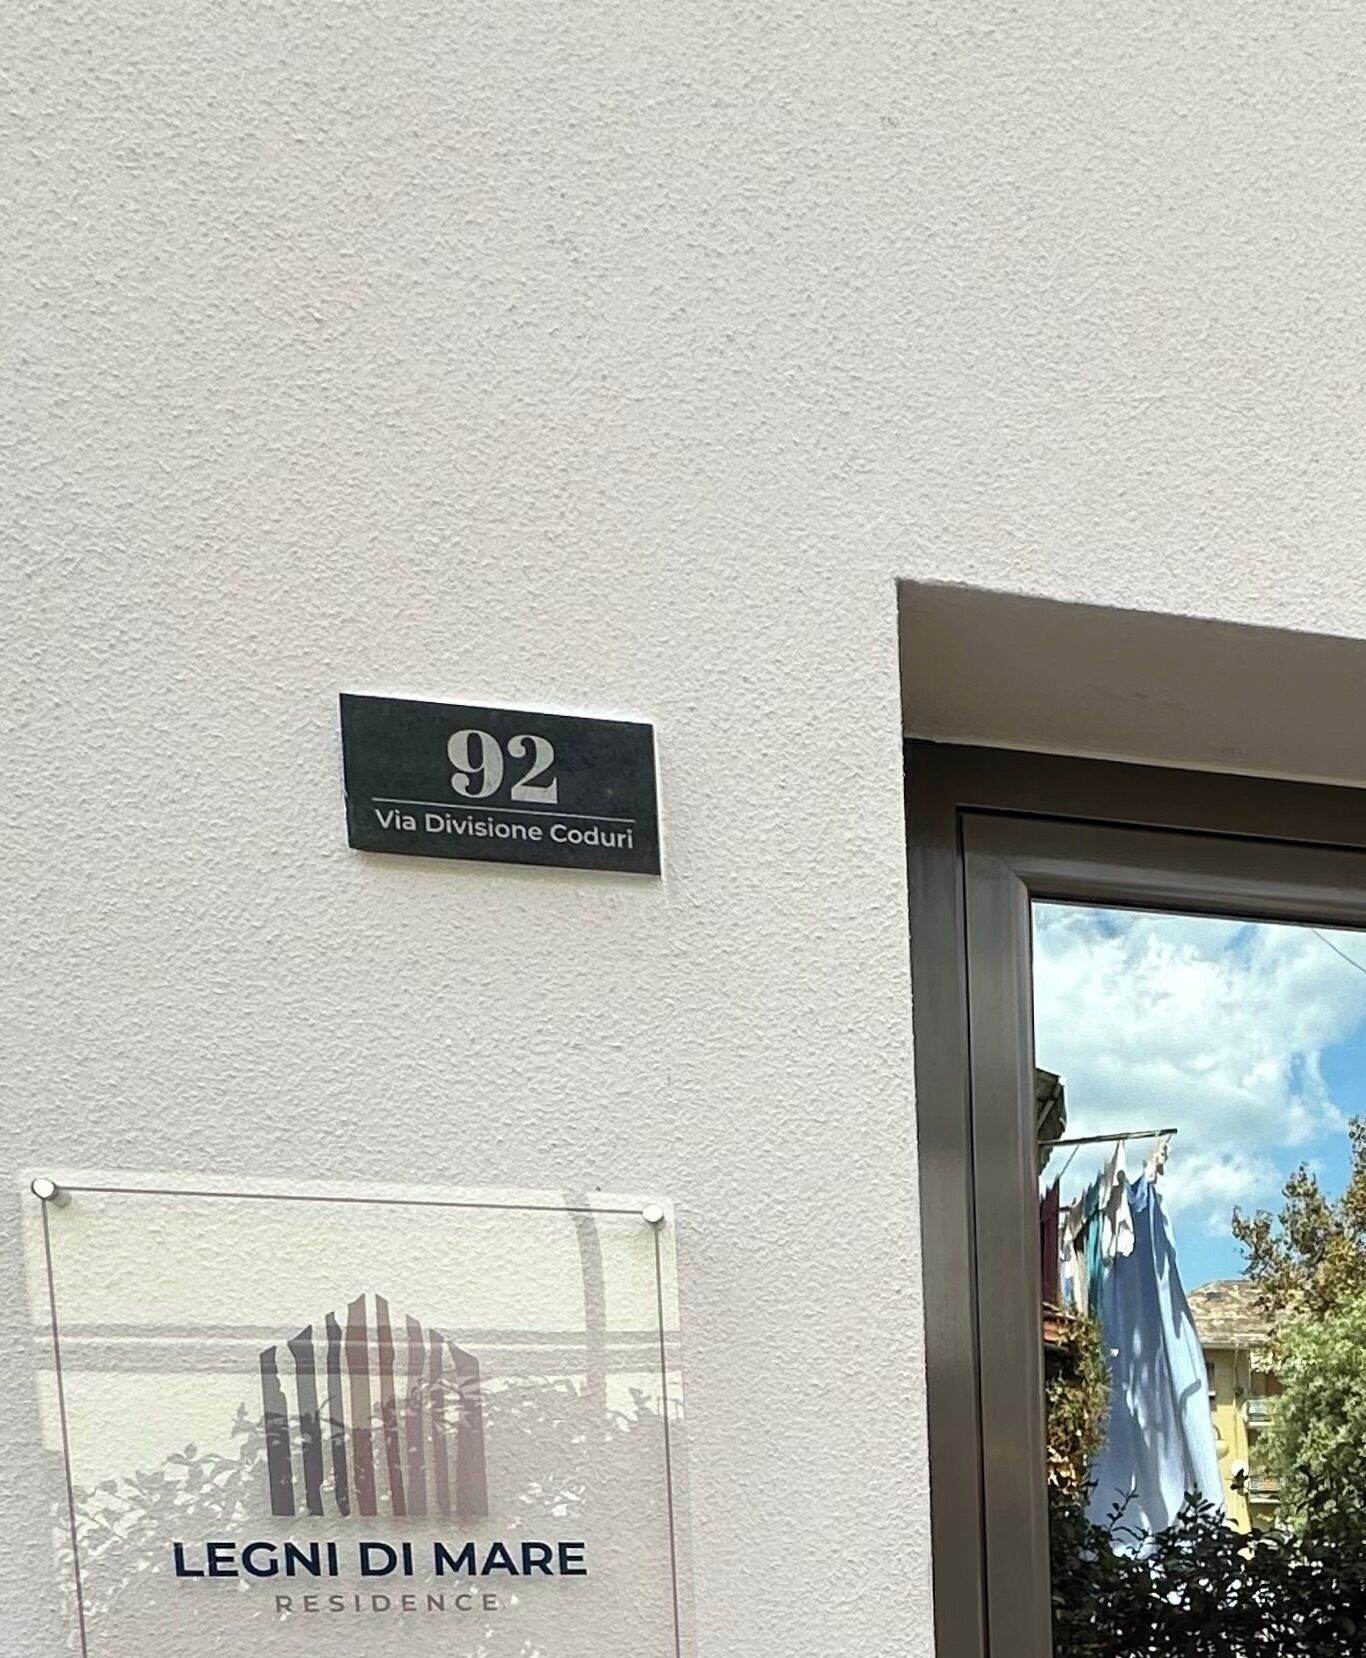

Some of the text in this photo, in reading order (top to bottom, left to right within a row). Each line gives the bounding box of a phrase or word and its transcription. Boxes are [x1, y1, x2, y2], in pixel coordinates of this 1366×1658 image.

[447, 728, 558, 804] 92
[374, 807, 634, 849] Via Divisione Coduri
[173, 1541, 588, 1578] LEGNI DI MARE
[275, 1593, 499, 1613] RESIDENCE
